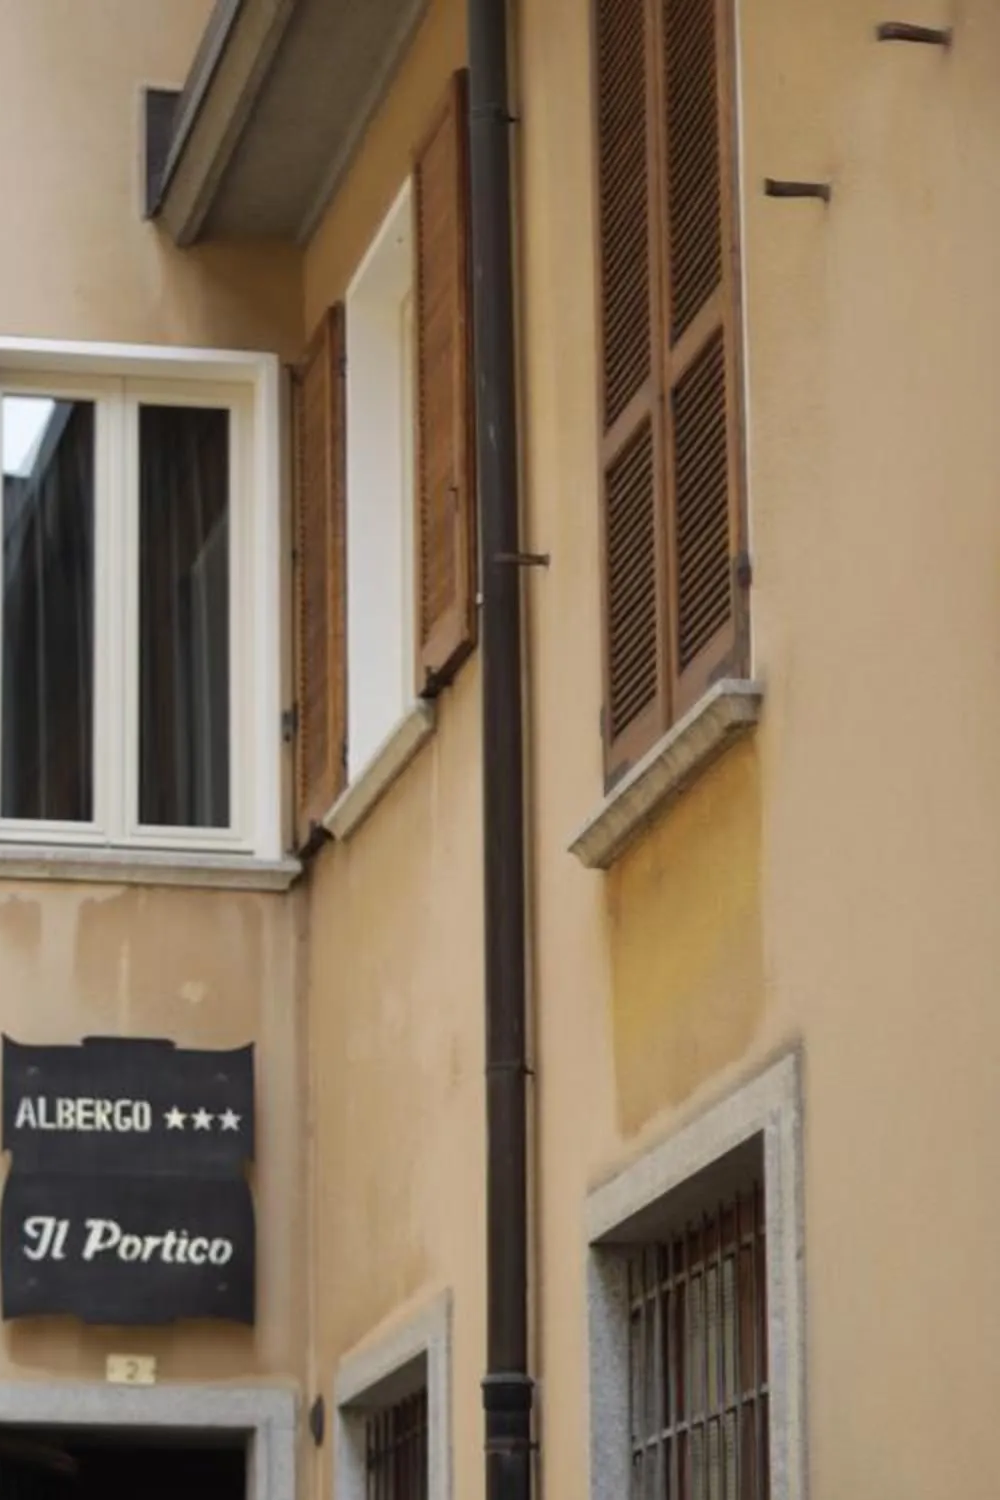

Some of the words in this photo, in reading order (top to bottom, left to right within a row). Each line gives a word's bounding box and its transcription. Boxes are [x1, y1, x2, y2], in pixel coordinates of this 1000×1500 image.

[15, 1096, 152, 1132] ALBERGO
[22, 1216, 70, 1260] Il
[82, 1218, 233, 1265] Portico
